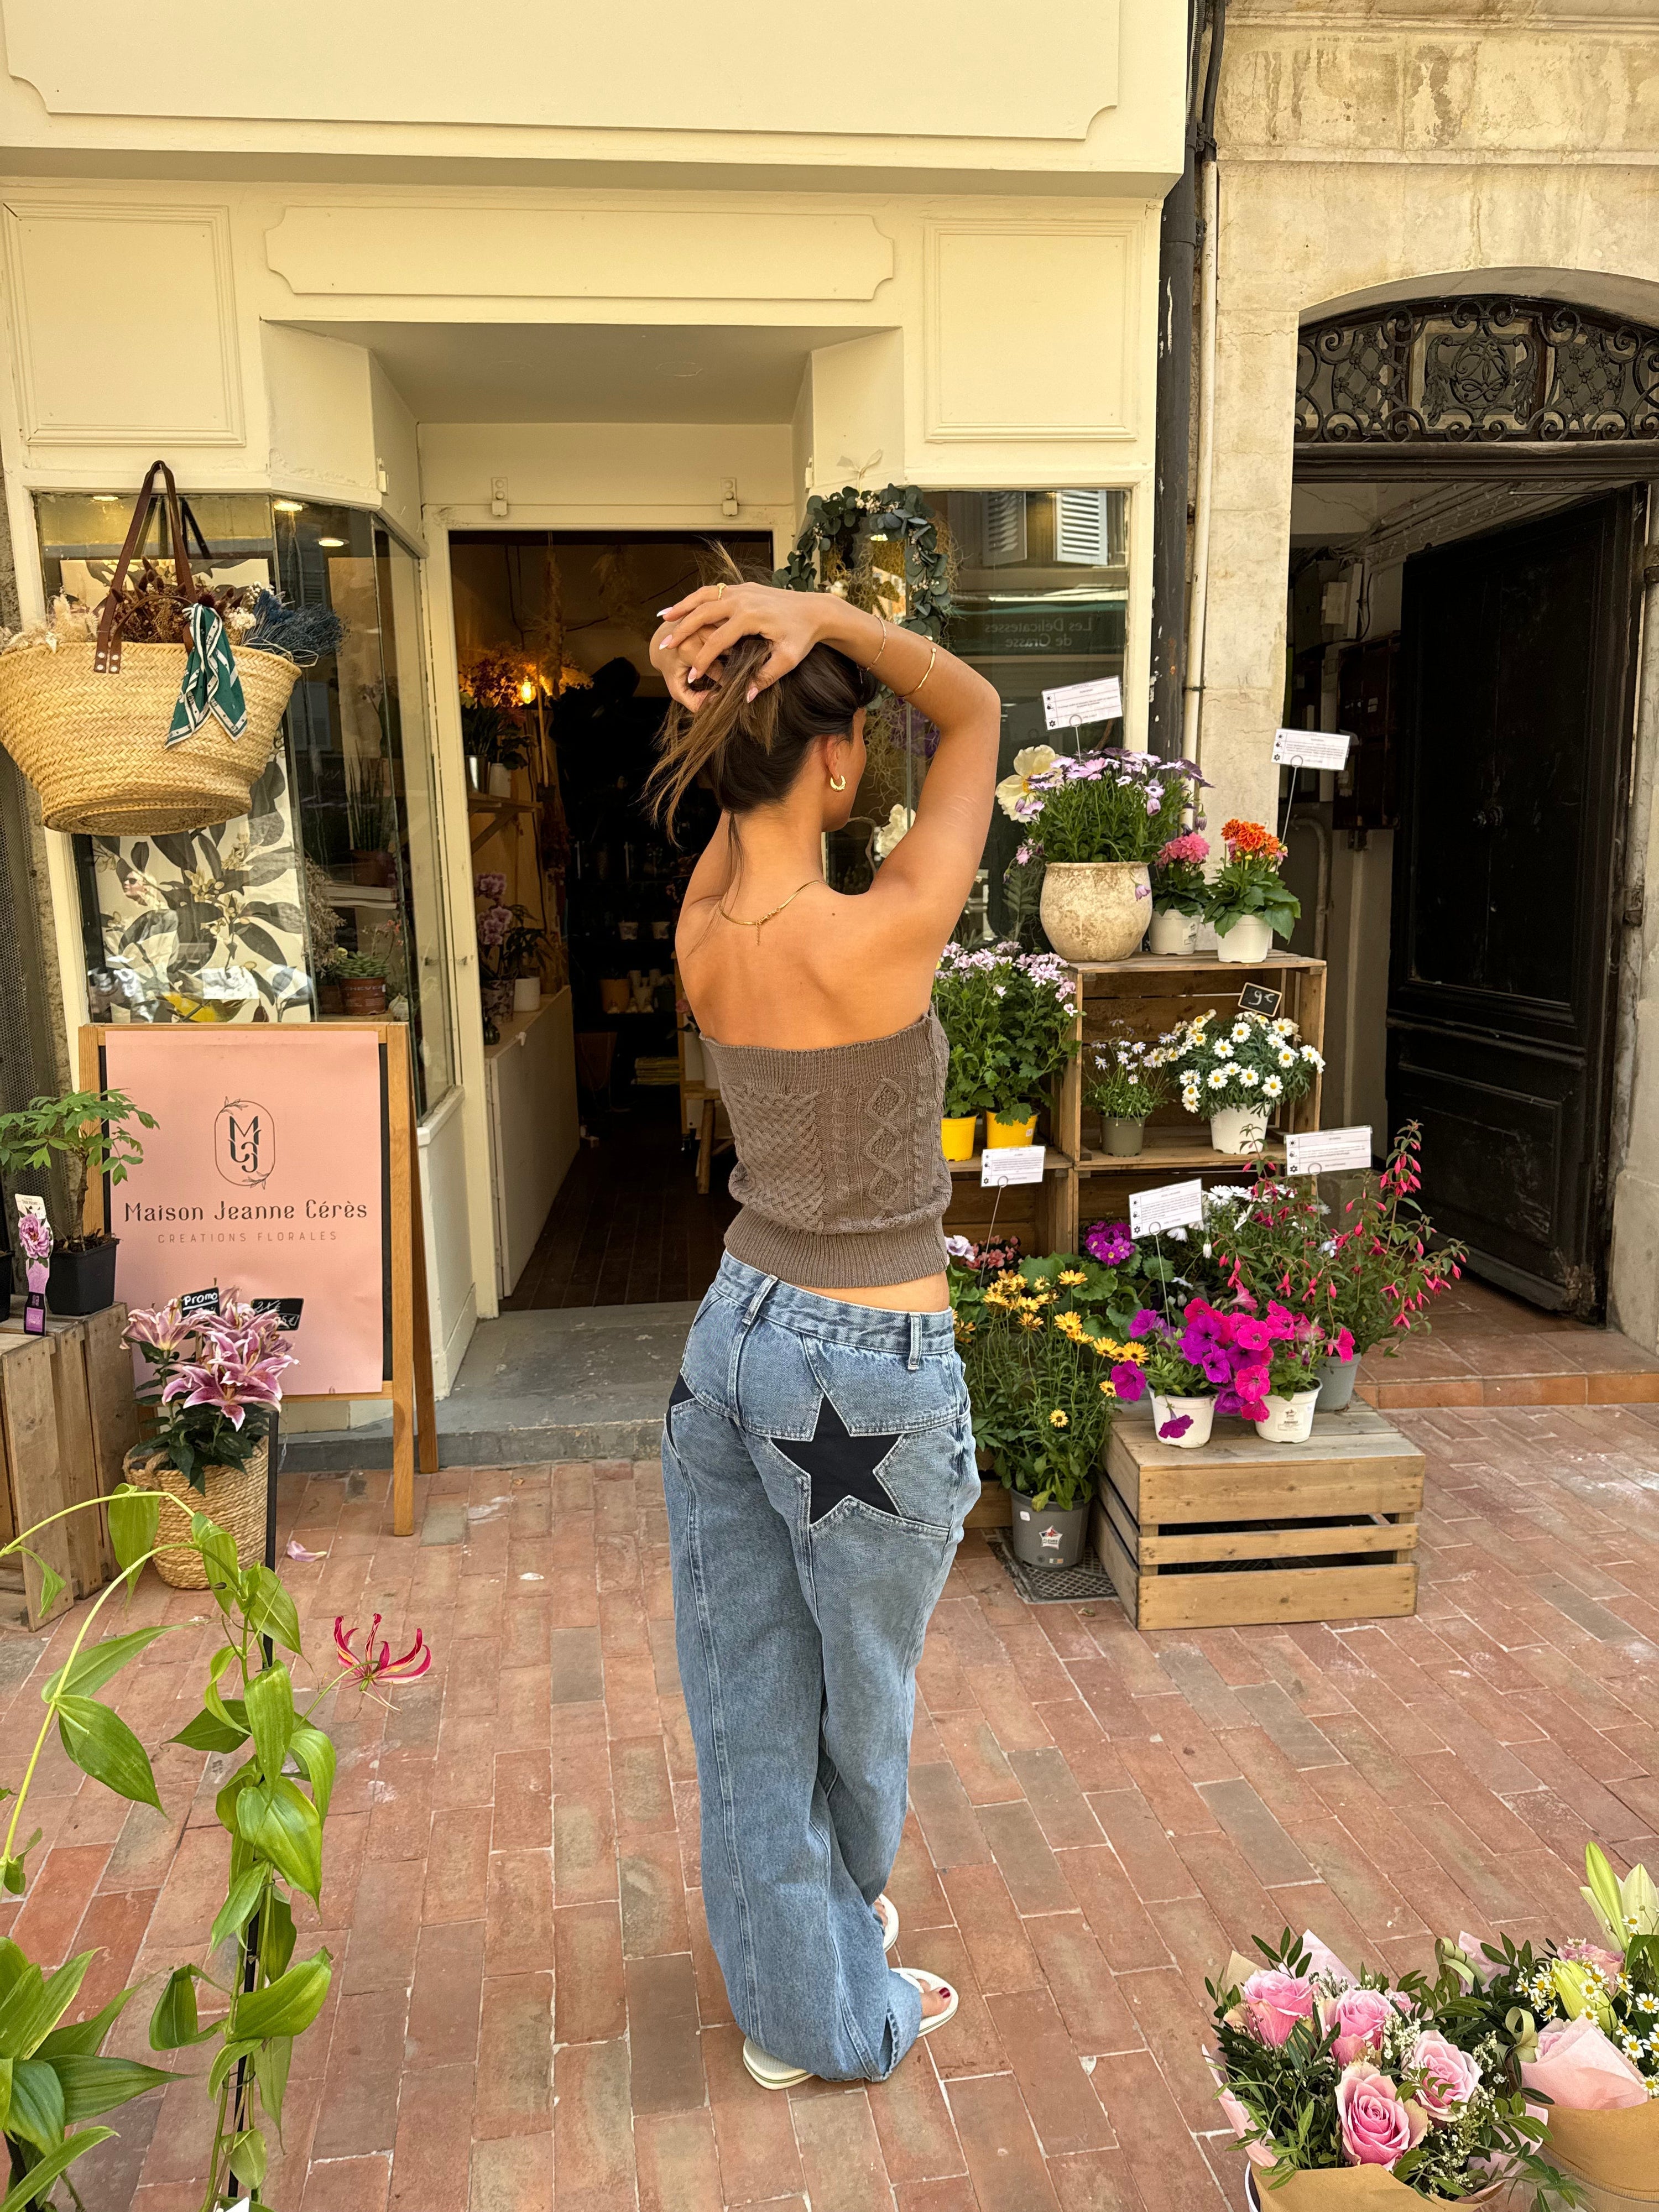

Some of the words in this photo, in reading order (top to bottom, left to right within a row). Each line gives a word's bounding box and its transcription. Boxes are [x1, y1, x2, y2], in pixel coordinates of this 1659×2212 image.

[1248, 990, 1275, 1005] 9€
[124, 1202, 204, 1222] Maison
[214, 1201, 294, 1220] Jeanne
[306, 1199, 367, 1218] Cérès
[158, 1233, 246, 1244] CREATIONS
[258, 1232, 337, 1241] FLORALES
[183, 1292, 217, 1306] Promo
